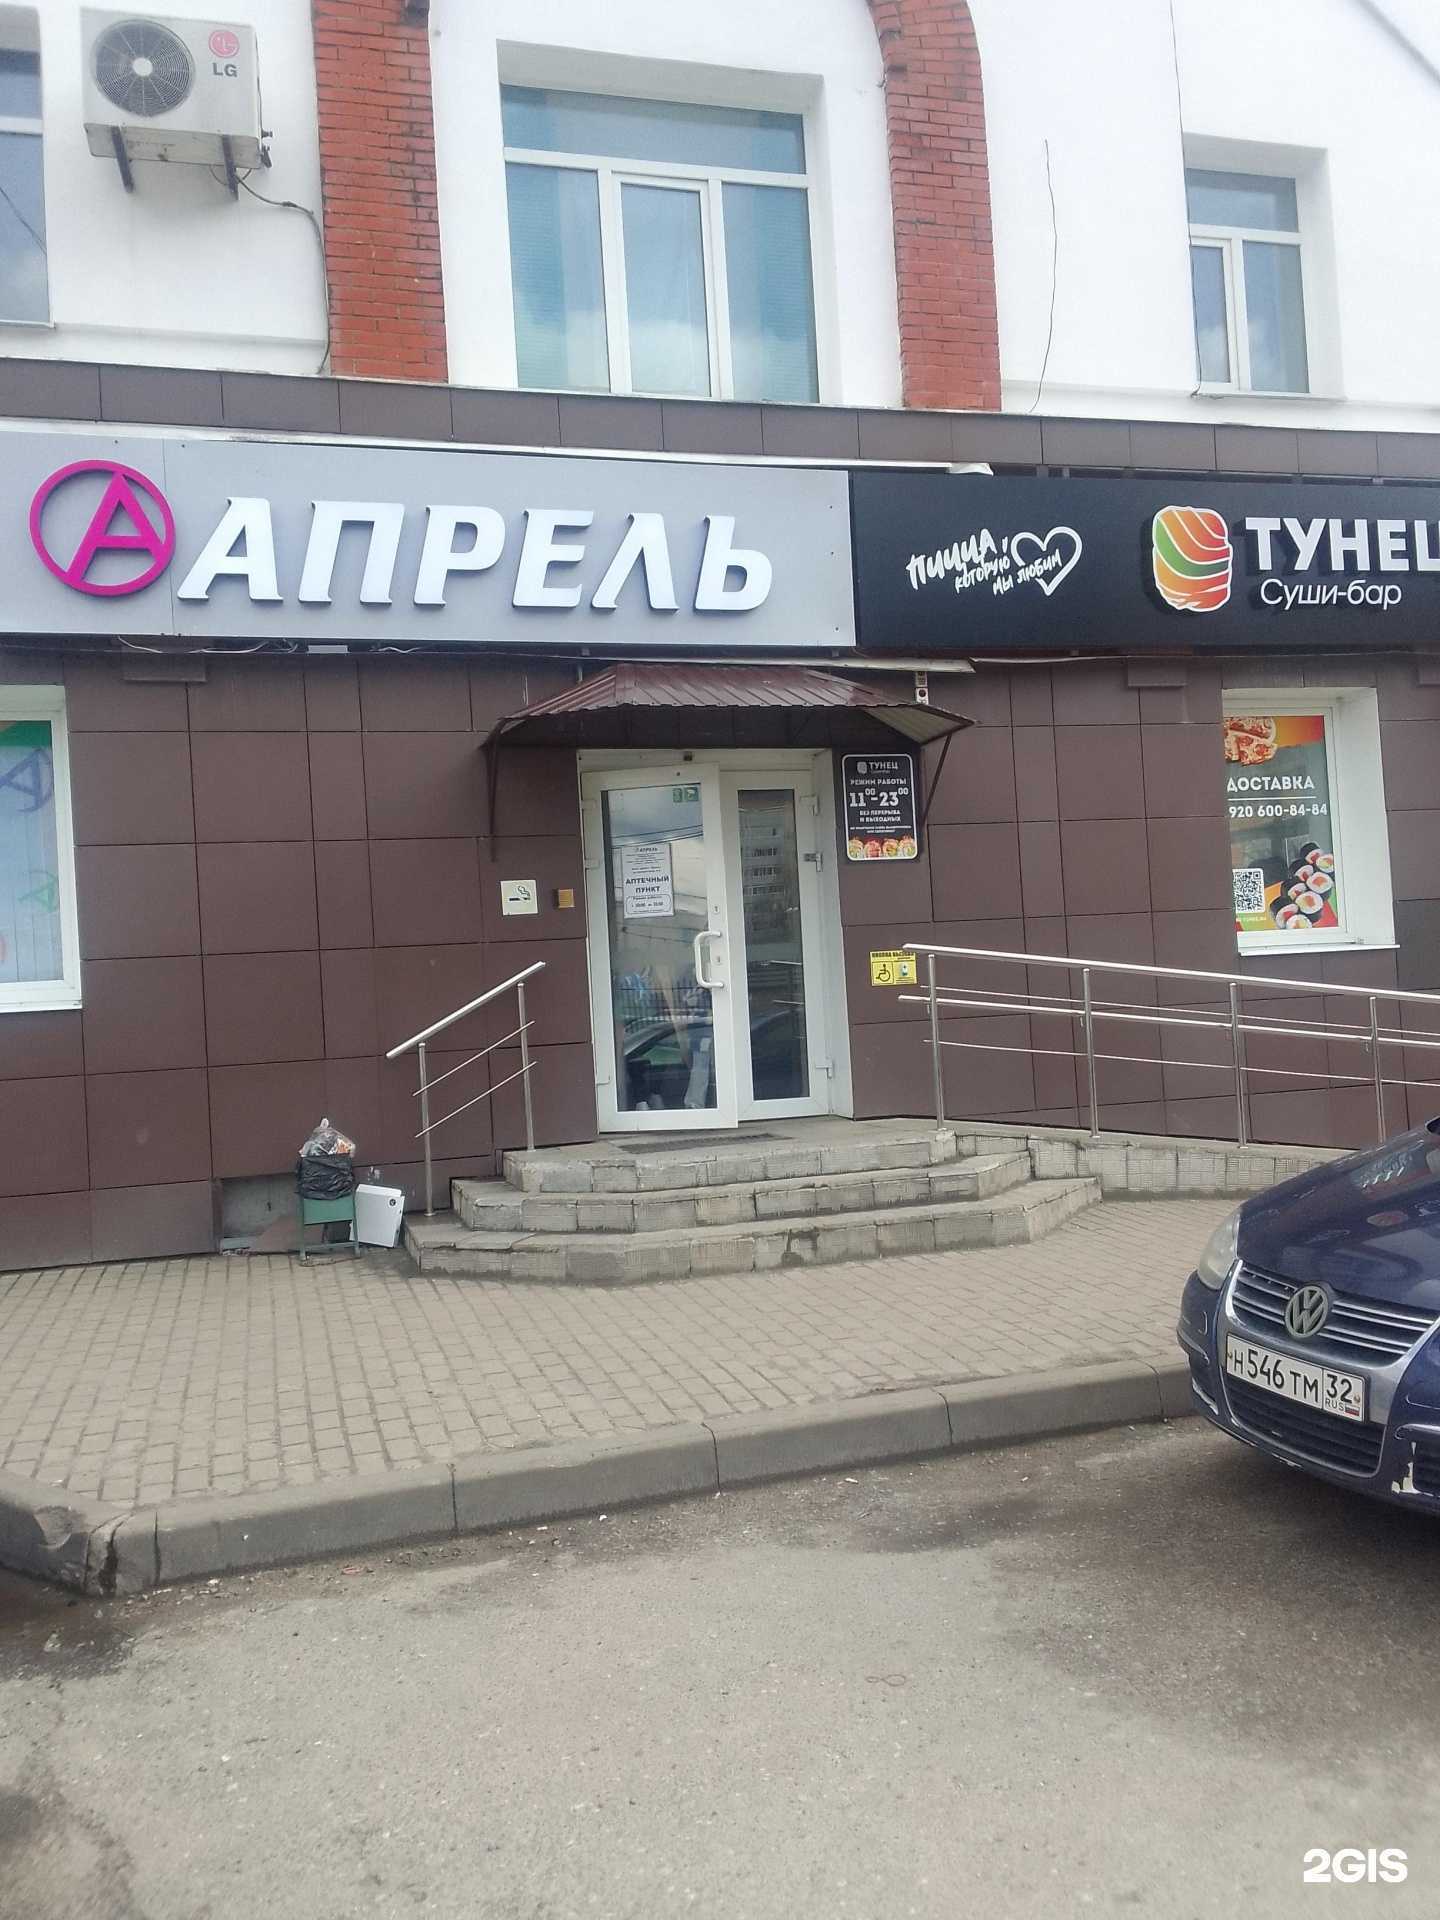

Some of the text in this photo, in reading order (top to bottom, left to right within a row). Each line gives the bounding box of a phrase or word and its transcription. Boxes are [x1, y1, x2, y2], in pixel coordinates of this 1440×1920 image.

[212, 62, 238, 78] LG
[176, 497, 773, 611] АПРЕЛЬ
[1260, 578, 1402, 610] Суши-бар
[869, 761, 899, 770] ТУНЕЦ
[1227, 776, 1315, 792] ДОСТАВКА
[1257, 803, 1328, 817] 600-84-84
[625, 876, 670, 885] АПТЕЧНЫЙ
[1325, 1398, 1344, 1412] RUS
